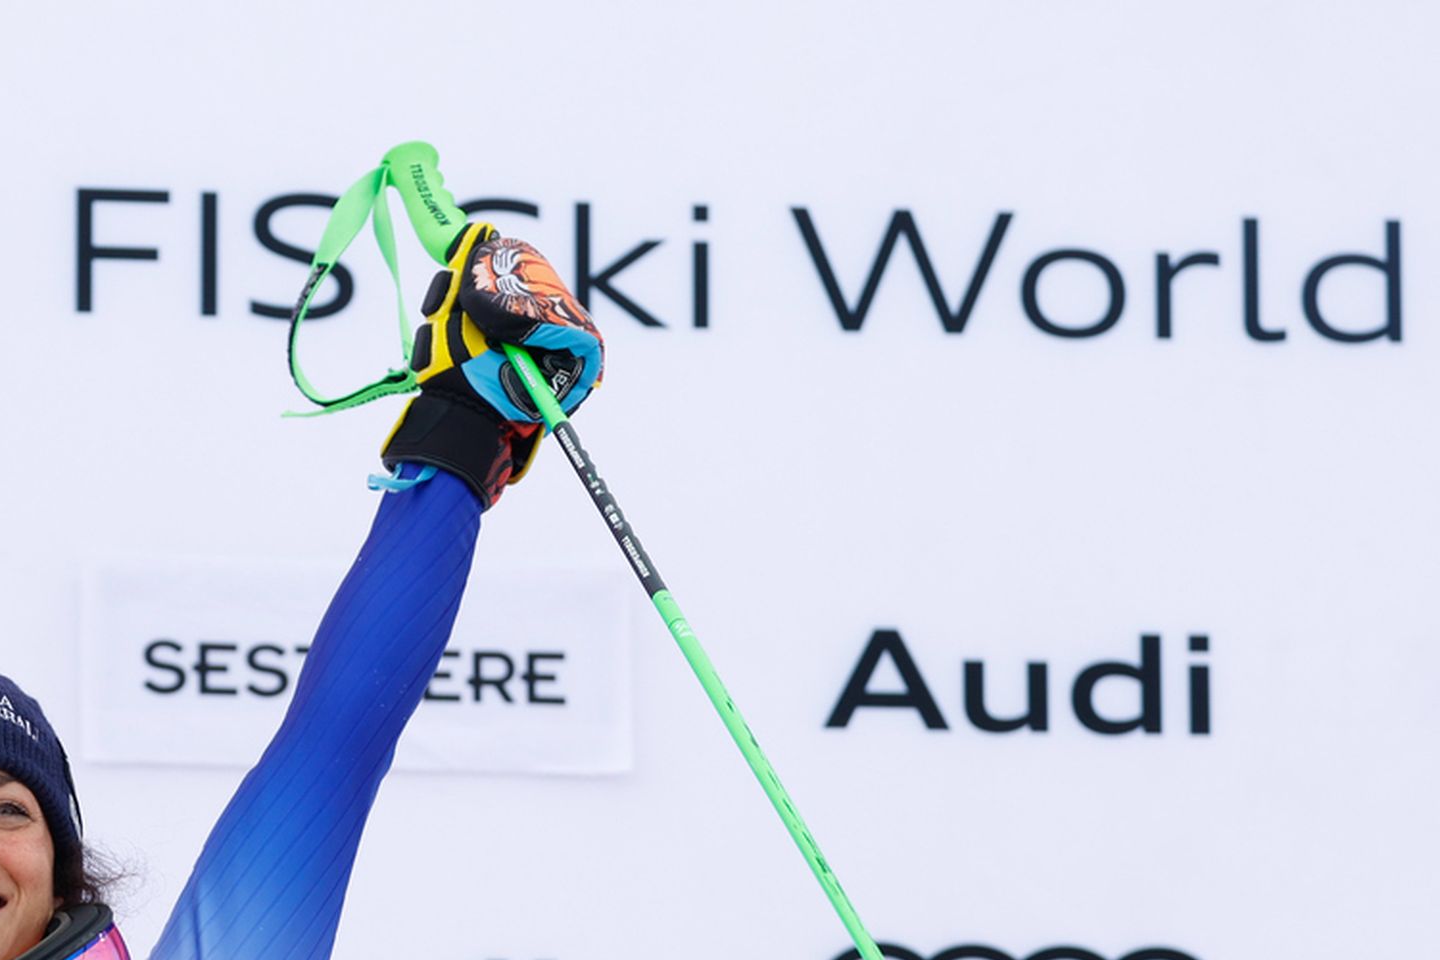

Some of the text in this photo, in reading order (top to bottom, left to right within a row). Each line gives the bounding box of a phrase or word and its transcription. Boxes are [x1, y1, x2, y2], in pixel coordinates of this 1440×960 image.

[75, 187, 356, 322] FIS
[790, 207, 1404, 344] World
[824, 628, 1211, 736] Audi
